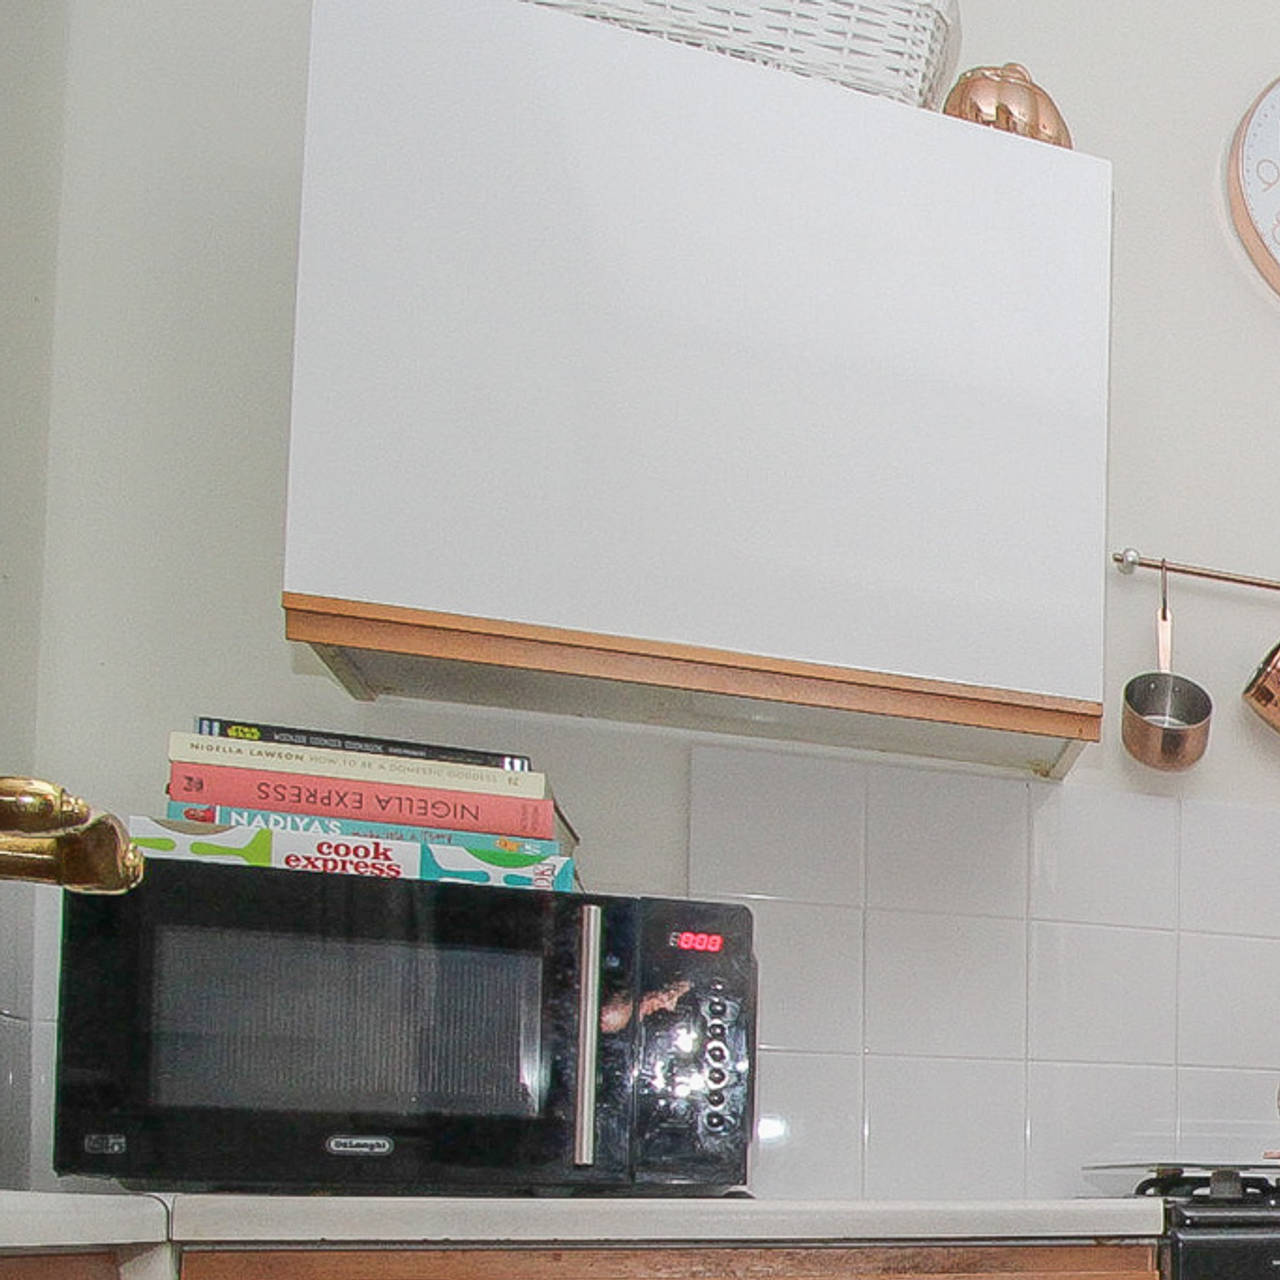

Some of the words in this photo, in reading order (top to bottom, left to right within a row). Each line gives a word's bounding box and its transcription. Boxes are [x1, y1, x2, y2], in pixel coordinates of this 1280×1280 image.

[1256, 159, 1280, 192] 9
[249, 750, 304, 762] LAWSON
[257, 782, 364, 810] EXPRESS
[375, 794, 479, 821] NIGELLA
[231, 811, 342, 836] NADIYA'S
[316, 841, 393, 861] cook
[284, 853, 403, 878] express
